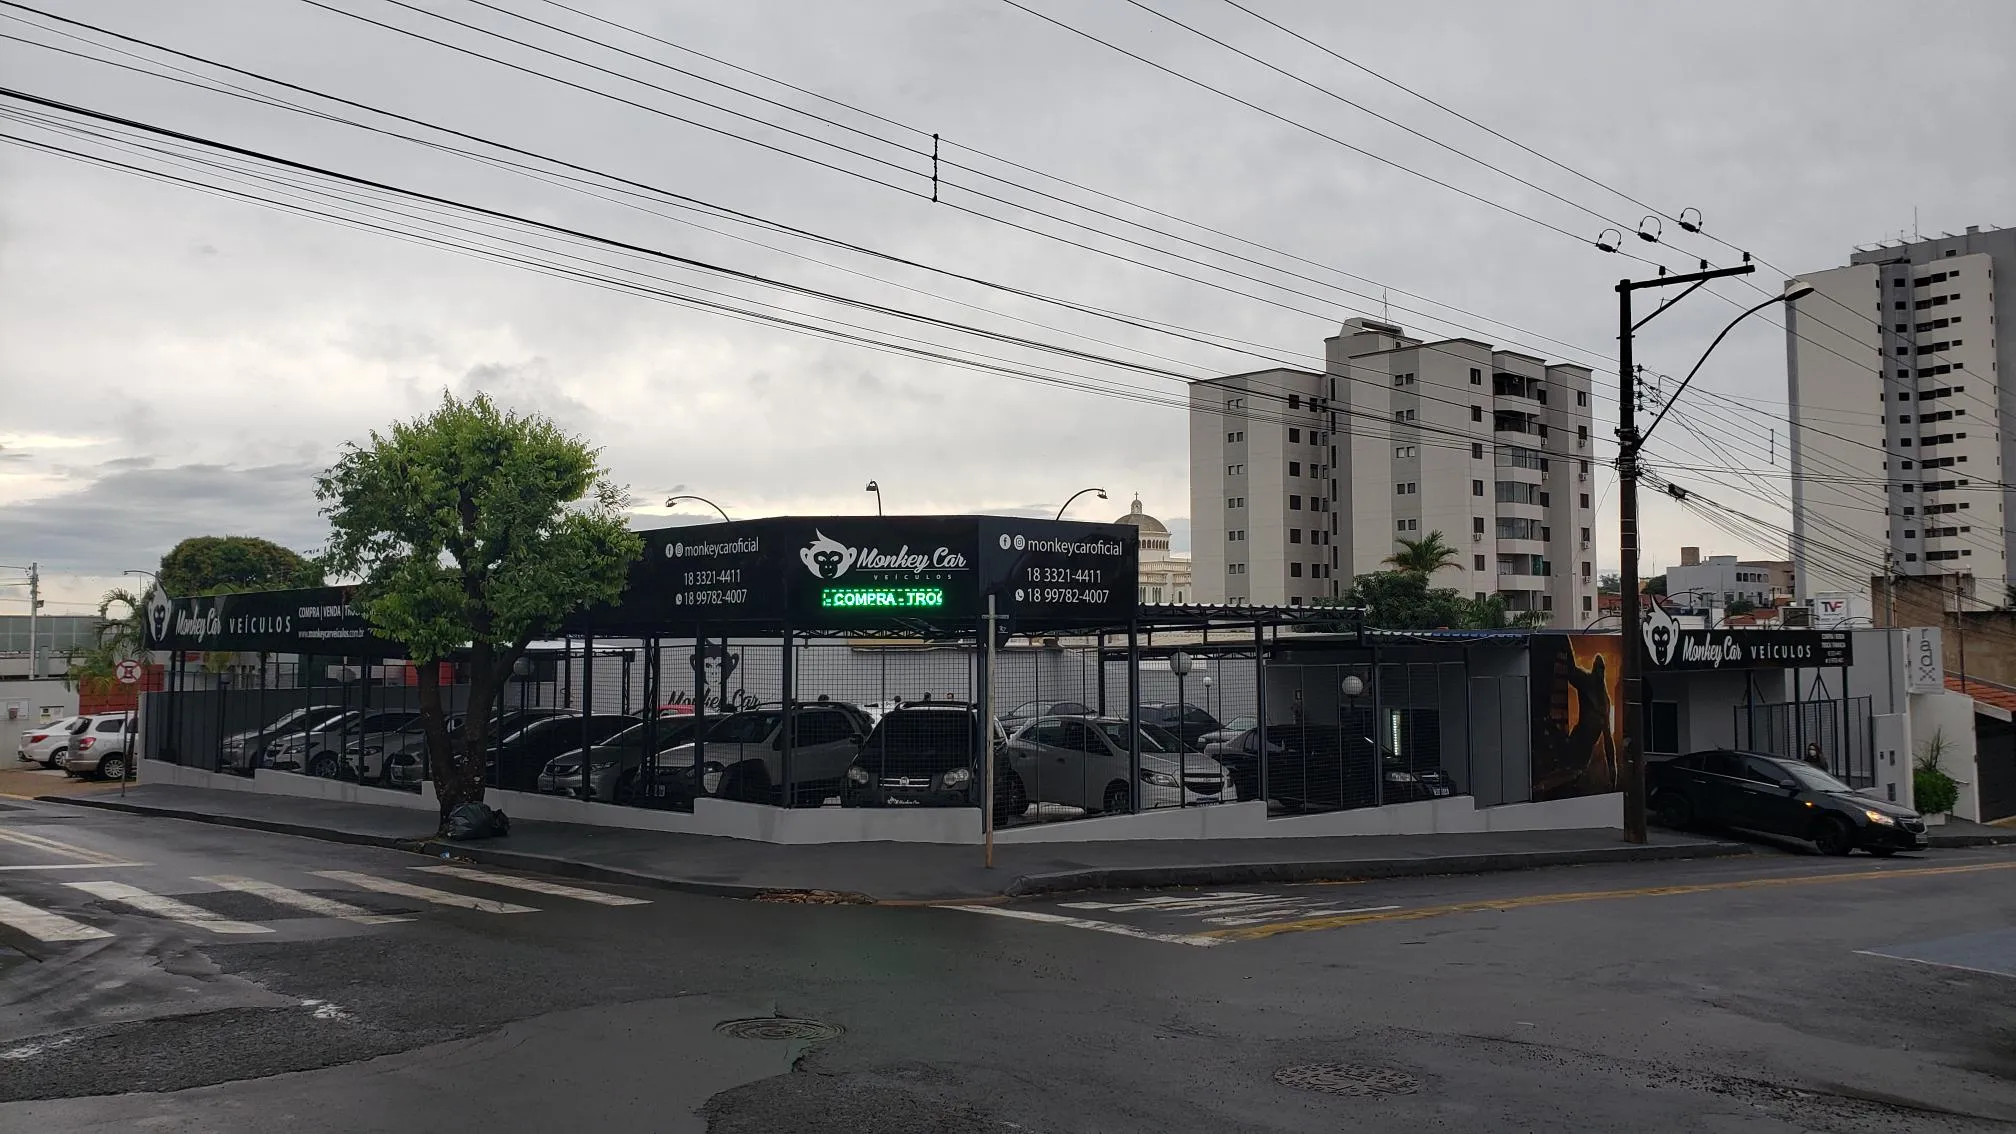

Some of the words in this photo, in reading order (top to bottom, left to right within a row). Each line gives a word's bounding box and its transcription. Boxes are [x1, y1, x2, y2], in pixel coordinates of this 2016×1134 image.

[684, 536, 760, 558] monkeycaroficial
[1028, 538, 1123, 556] monkeycaroficial
[857, 544, 930, 574] Monkey
[932, 547, 968, 568] Car
[684, 572, 694, 586] 18
[696, 568, 741, 585] 3321-4411
[1026, 567, 1041, 582] 18
[1044, 568, 1102, 583] 3321-4411
[684, 591, 694, 605] 18
[696, 589, 748, 605] 99782-4007
[834, 592, 896, 606] COMPRA
[1027, 588, 1041, 603] 18
[1044, 588, 1110, 604] 99782-4007
[298, 607, 320, 619] COMPRA
[323, 606, 341, 618] VENDA
[176, 606, 206, 644] Monkey
[206, 607, 222, 636] Car
[229, 613, 291, 635] VEÍCULOS
[1683, 633, 1723, 669] Monkey
[1724, 635, 1742, 662] Car
[1750, 642, 1812, 659] VEÍCULOS
